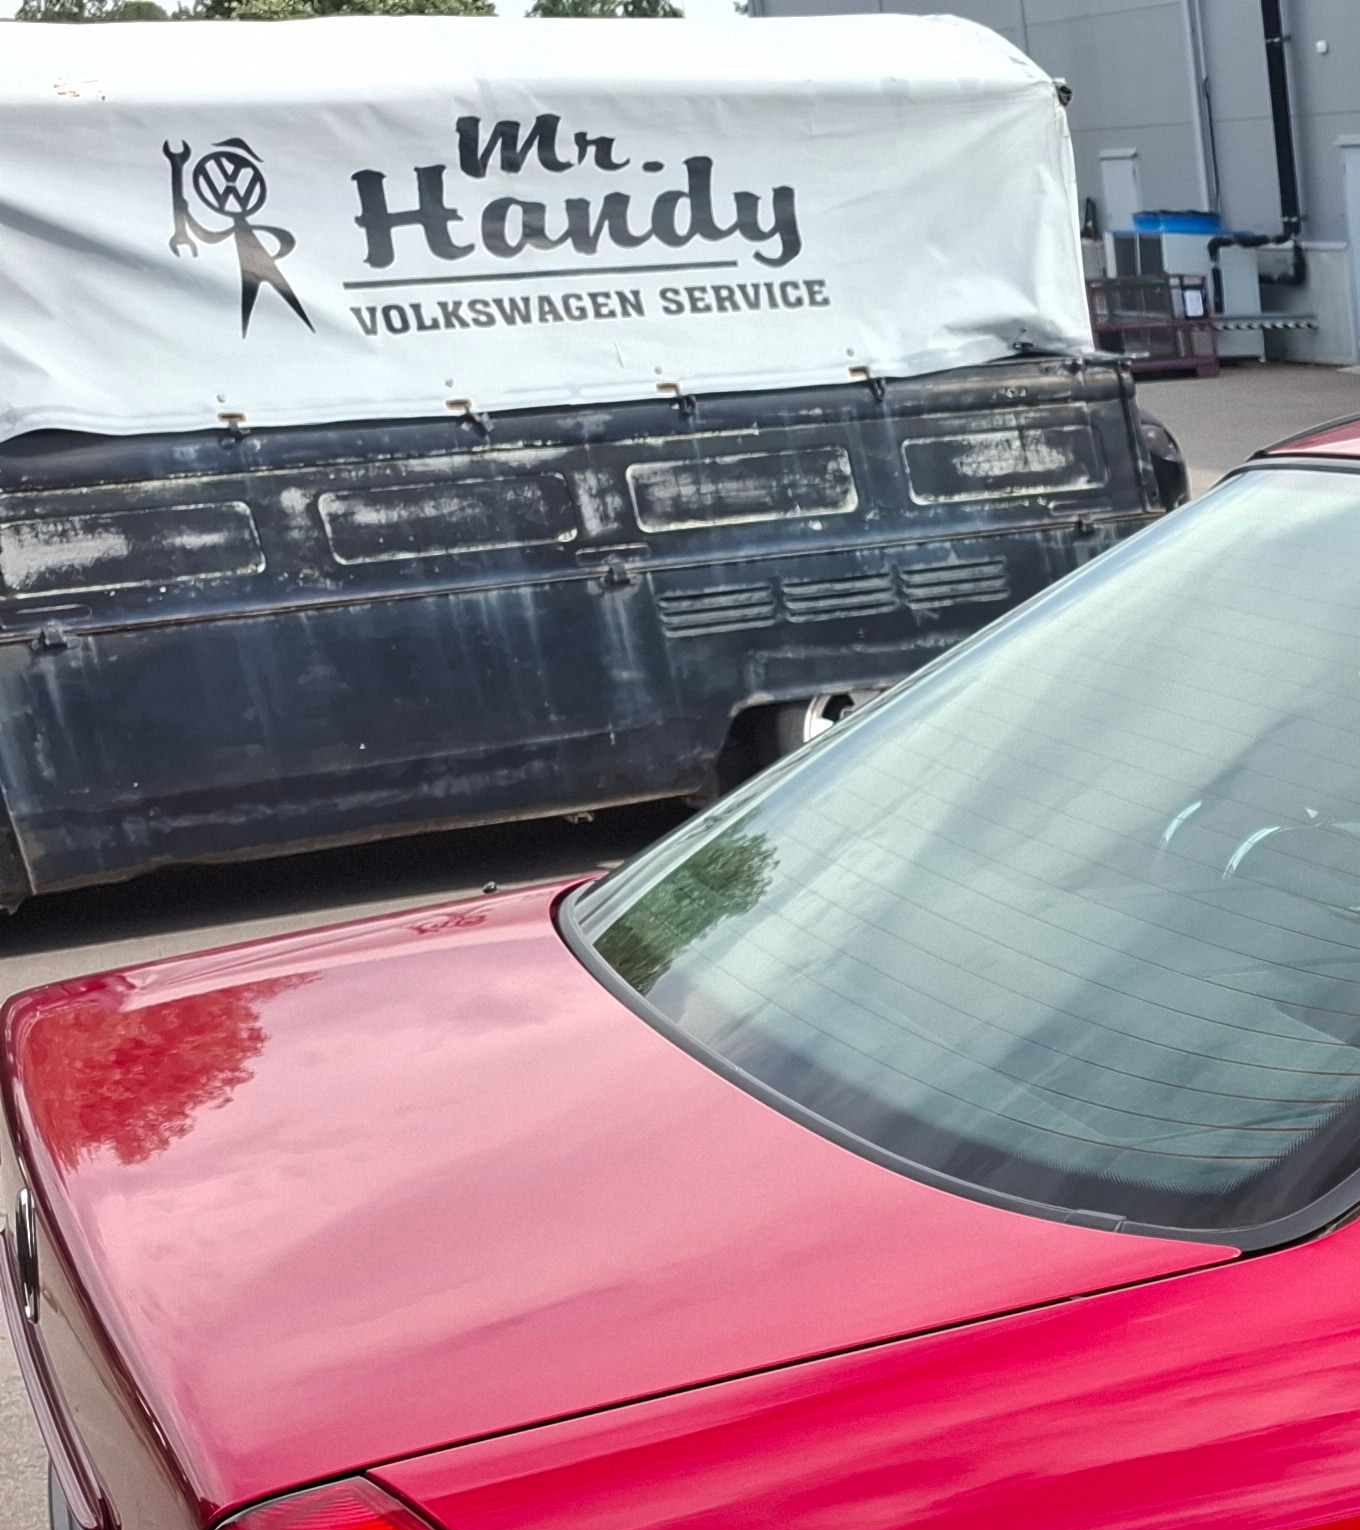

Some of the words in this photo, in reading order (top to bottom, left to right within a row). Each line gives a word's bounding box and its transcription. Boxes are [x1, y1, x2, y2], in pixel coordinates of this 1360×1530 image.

[455, 113, 664, 178] Mr.
[351, 155, 802, 269] Handy
[350, 287, 645, 337] VOLKSWAGEN
[661, 278, 831, 316] SERVICE
